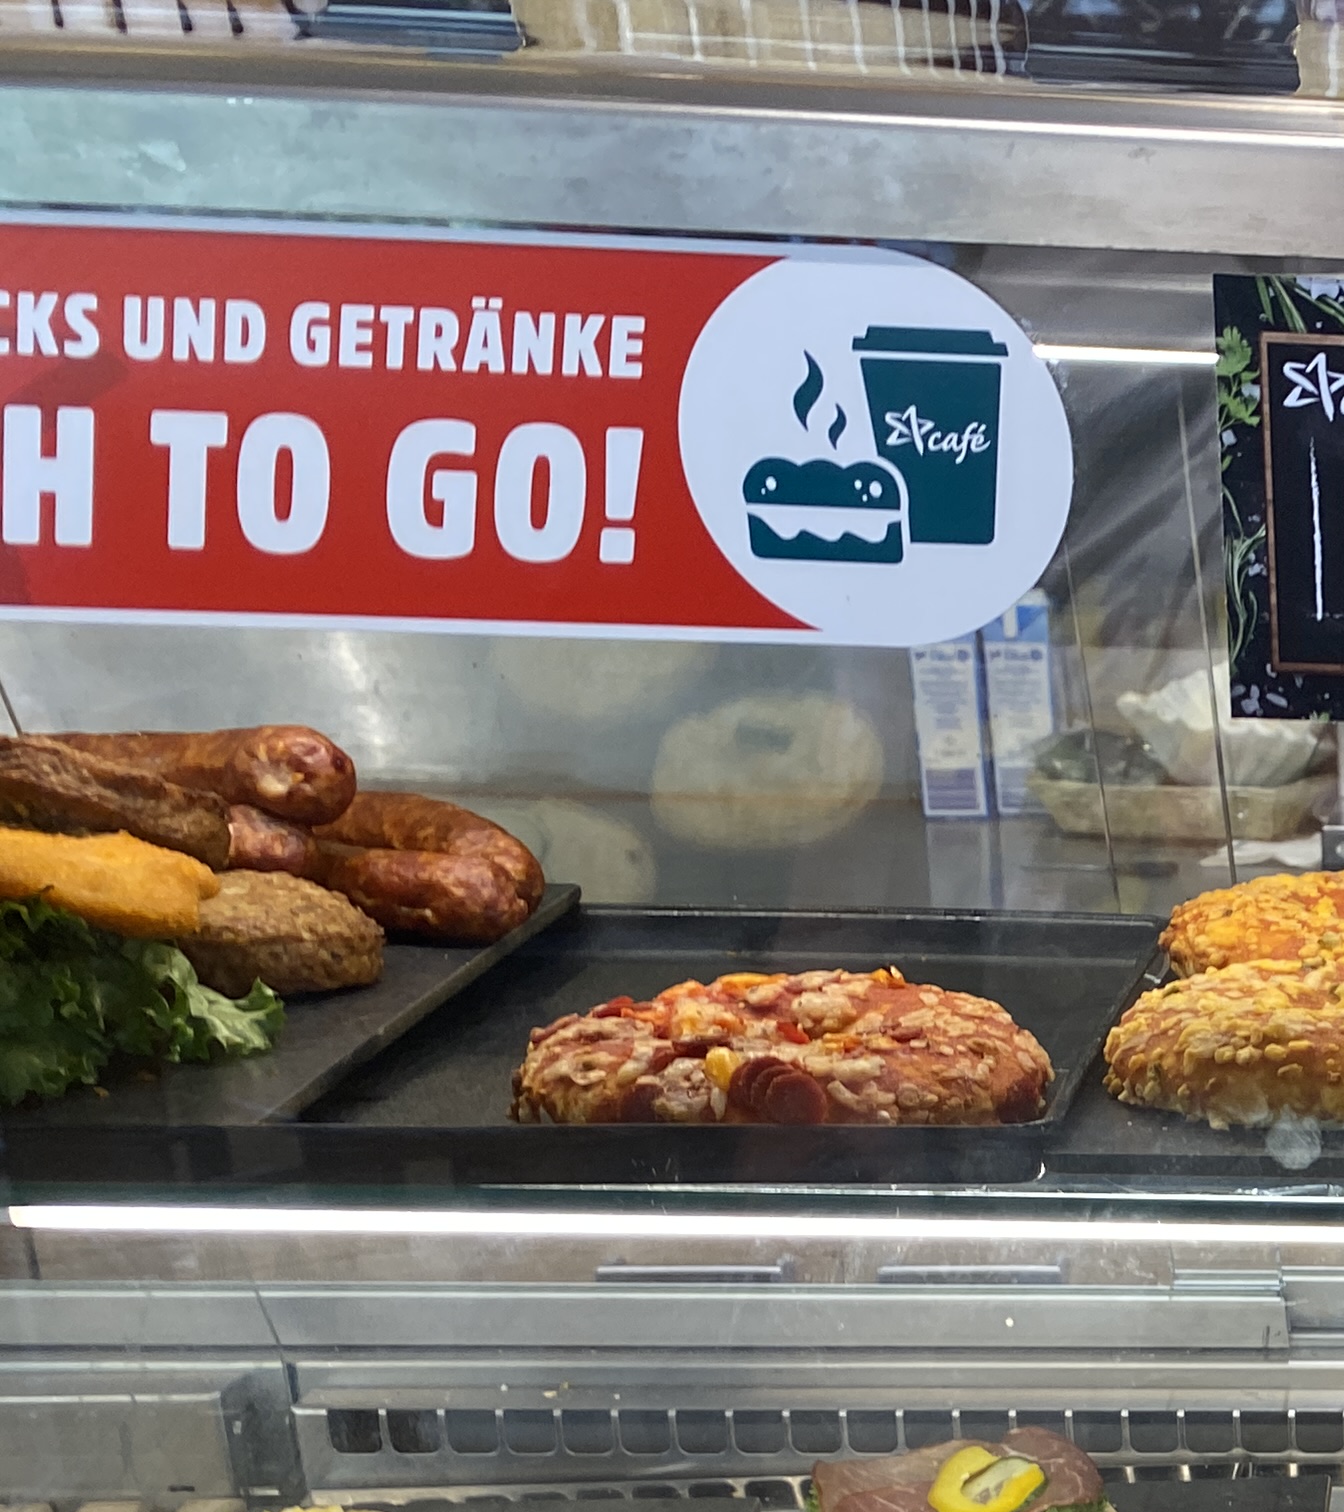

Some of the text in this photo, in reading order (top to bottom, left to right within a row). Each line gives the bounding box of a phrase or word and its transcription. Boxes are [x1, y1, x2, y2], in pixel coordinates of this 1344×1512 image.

[122, 294, 267, 364] UND
[289, 296, 645, 380] GETRÄNKE
[2, 403, 645, 565] H TO GO!
[927, 421, 991, 465] café
